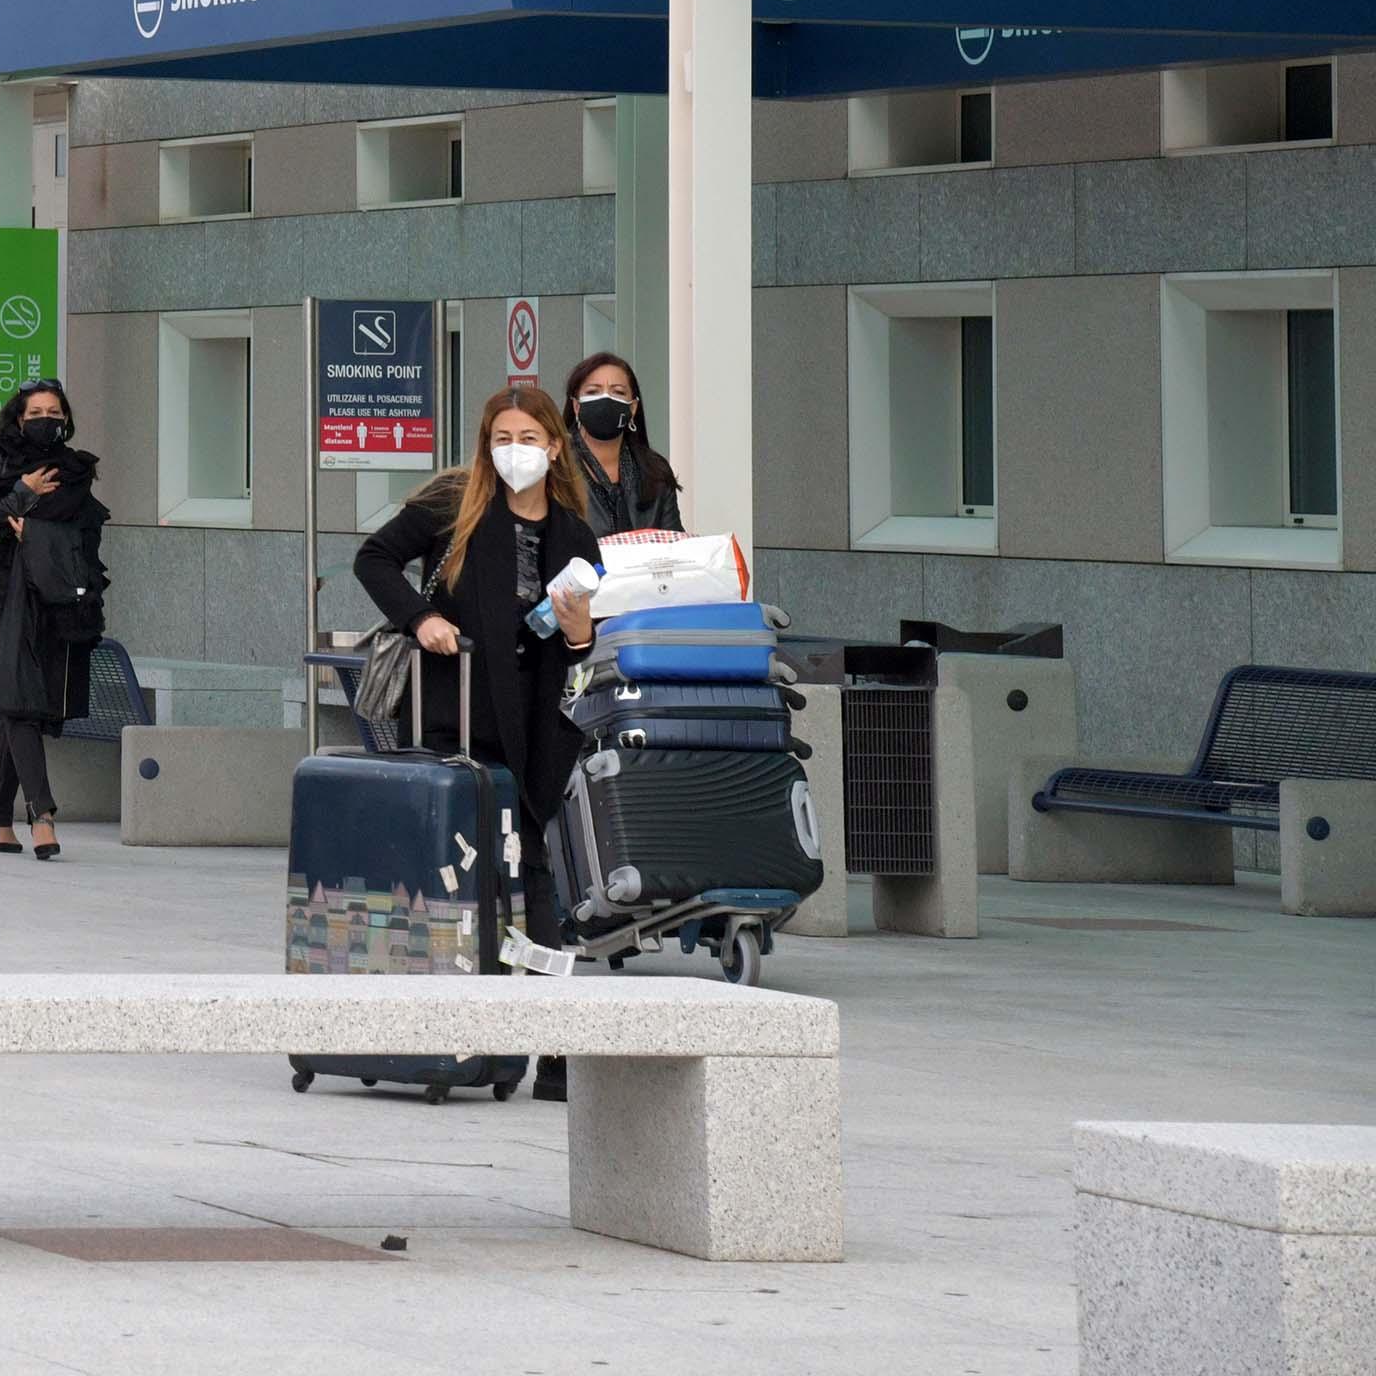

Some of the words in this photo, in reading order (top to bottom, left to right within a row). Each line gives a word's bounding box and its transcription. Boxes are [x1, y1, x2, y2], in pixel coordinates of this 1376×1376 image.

[327, 365, 383, 378] SMOKING
[387, 365, 423, 379] POINT
[327, 394, 366, 403] UTILIZZARE
[368, 394, 375, 403] IL
[376, 395, 423, 404] POSACENERE
[329, 408, 355, 416] PLEASE
[357, 408, 371, 417] USE
[373, 408, 386, 417] THE
[388, 409, 422, 418] ASHTRAY
